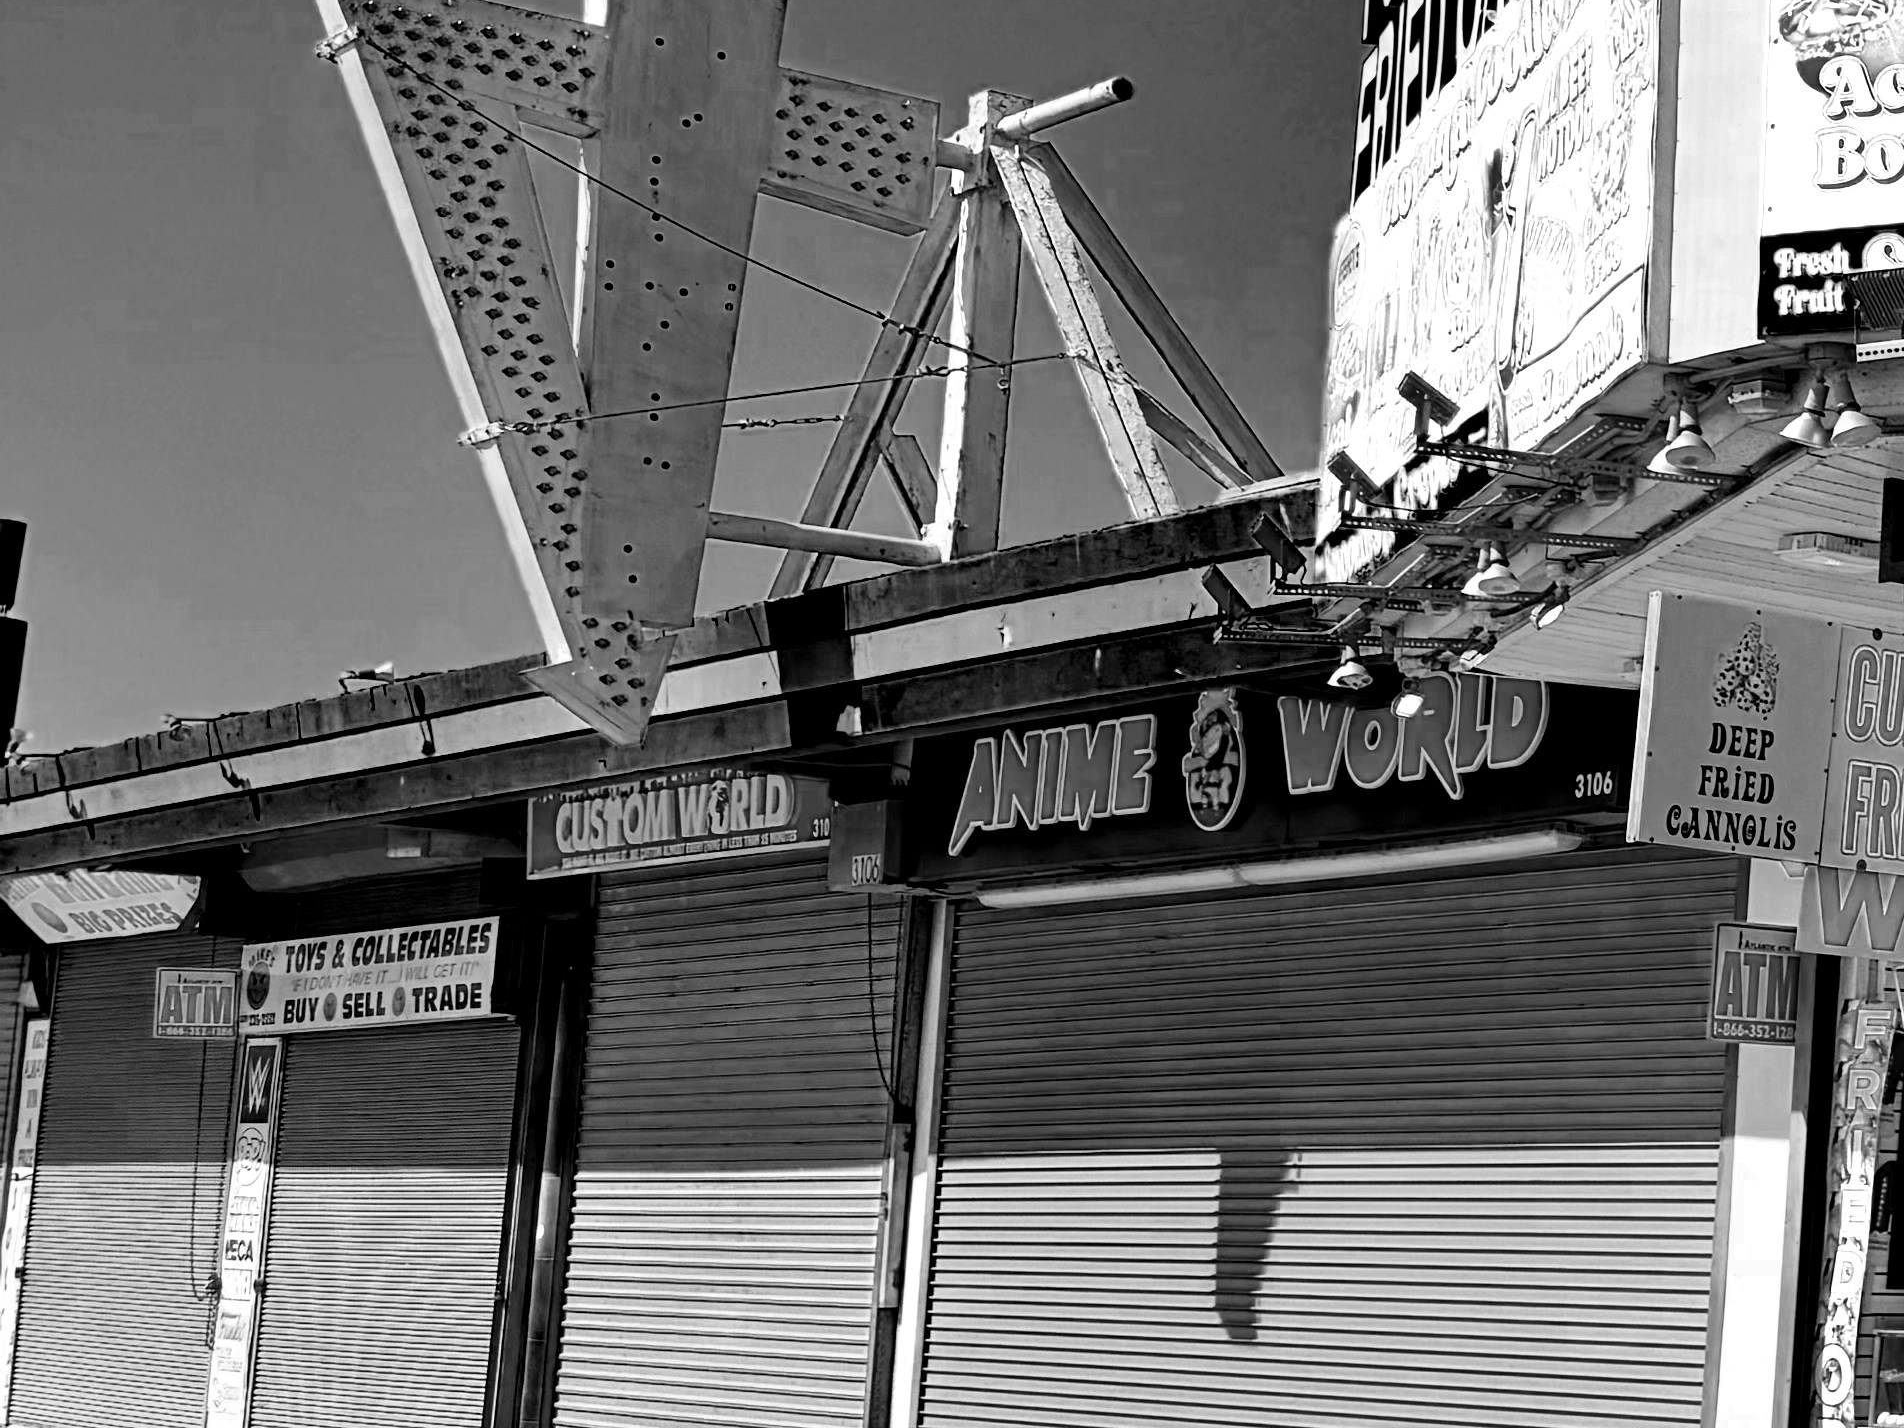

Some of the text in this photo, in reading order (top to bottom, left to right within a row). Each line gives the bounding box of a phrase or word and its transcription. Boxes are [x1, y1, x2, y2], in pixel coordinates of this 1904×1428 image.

[1708, 722, 1775, 762] DEEP
[948, 669, 1550, 856] ANIME WORLD
[1573, 771, 1614, 799] 3106
[556, 789, 677, 853] CUSTOM
[678, 774, 796, 838] WORLD
[852, 855, 880, 886] 3106
[68, 909, 113, 934] BIG
[285, 923, 492, 973] TOYS & COLLECTABLES
[160, 985, 233, 1024] ATM
[283, 996, 319, 1024] BUY
[342, 991, 386, 1019] SELL
[412, 983, 482, 1013] TRADE
[1716, 951, 1801, 1021] ATM
